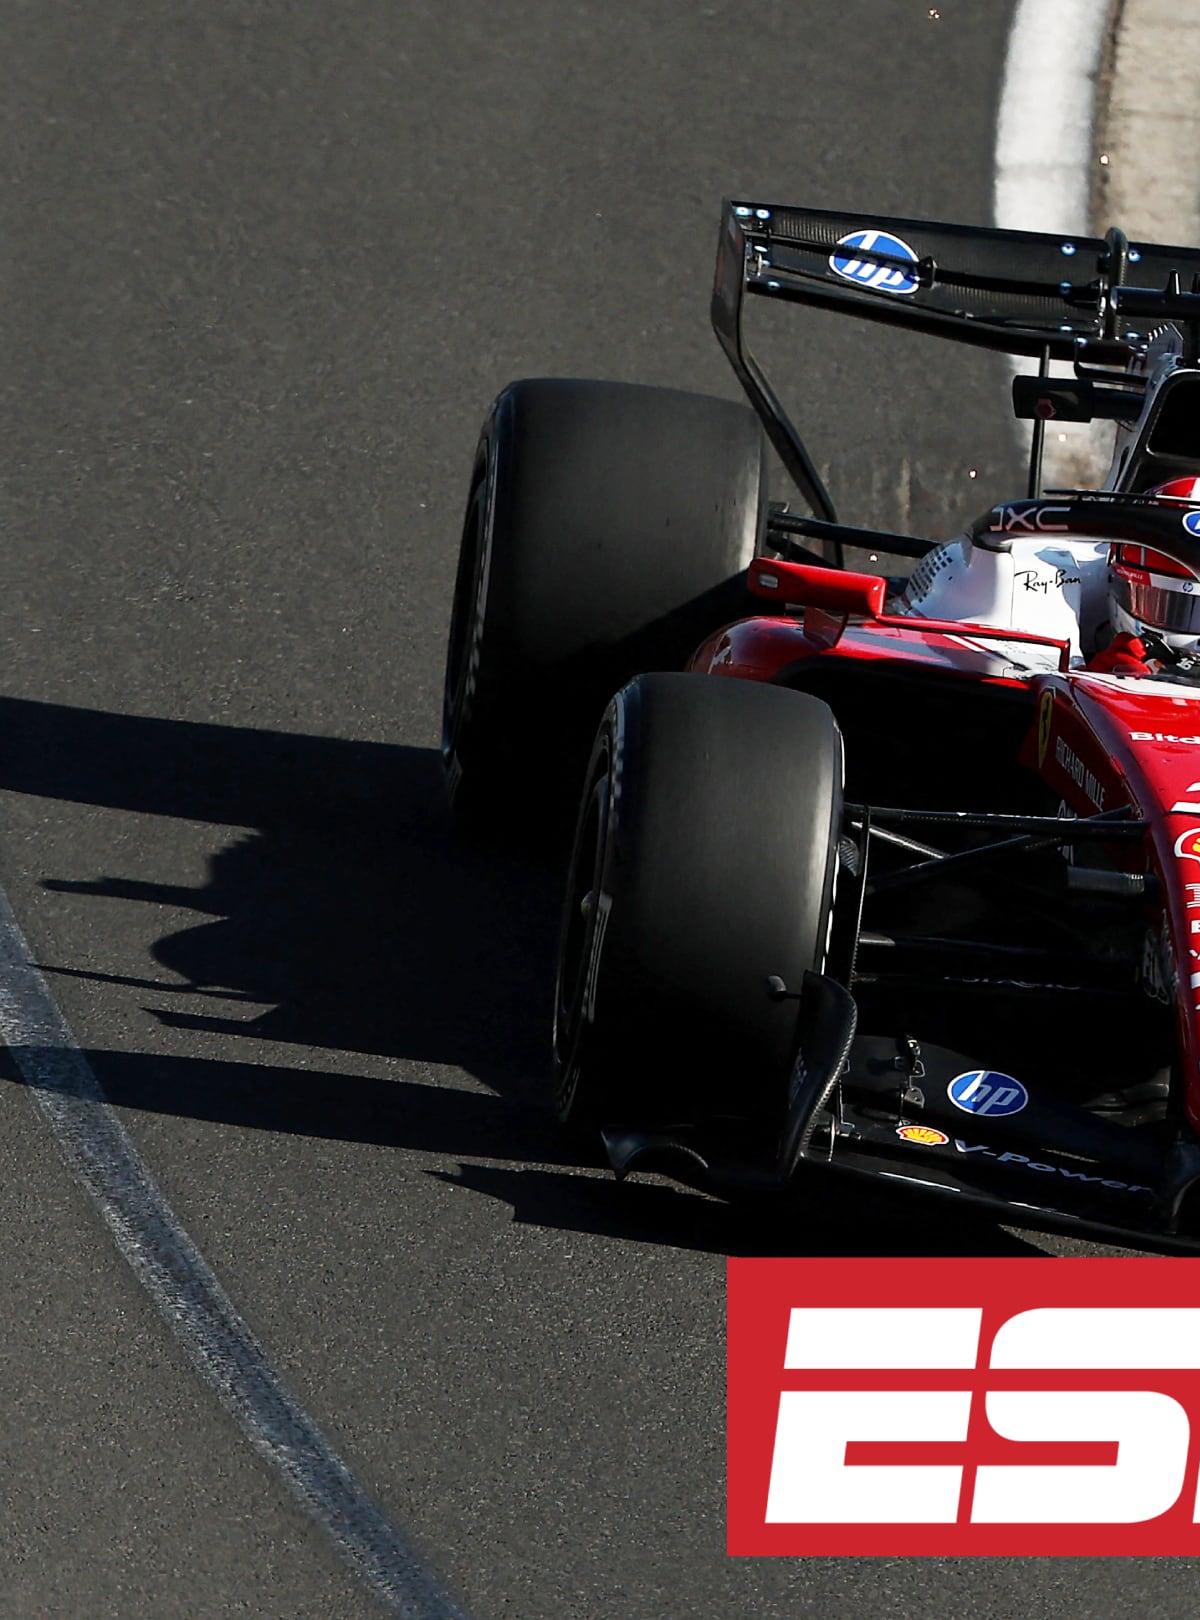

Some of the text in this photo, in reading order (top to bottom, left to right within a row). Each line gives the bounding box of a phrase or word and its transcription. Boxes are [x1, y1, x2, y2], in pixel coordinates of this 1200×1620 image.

[841, 231, 906, 287] hp
[1013, 568, 1081, 595] Ray-Ban
[1175, 657, 1195, 671] 16
[957, 1070, 1021, 1116] hp
[954, 1138, 1153, 1193] V-Power
